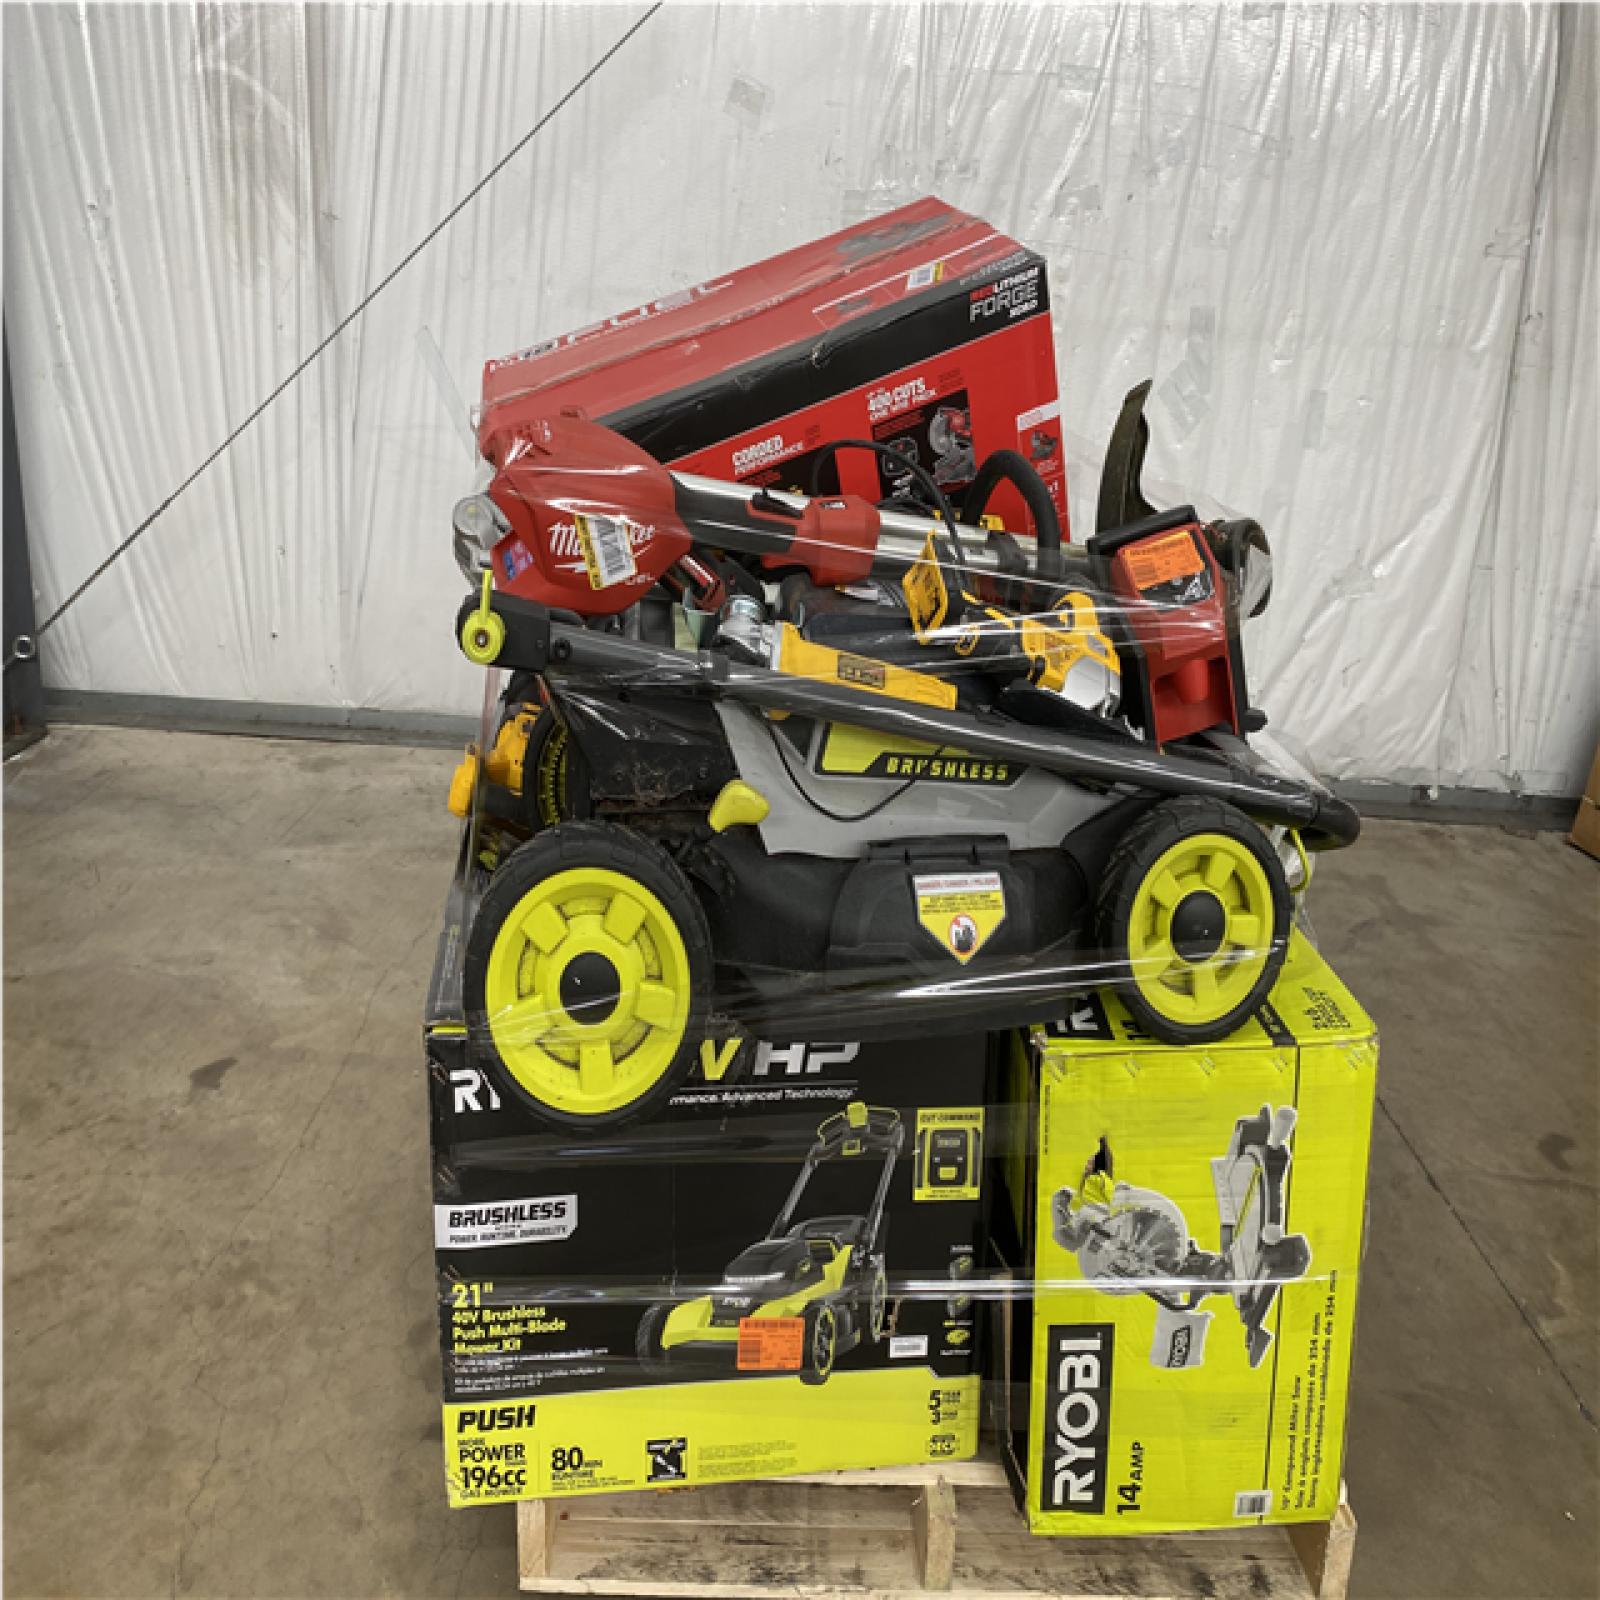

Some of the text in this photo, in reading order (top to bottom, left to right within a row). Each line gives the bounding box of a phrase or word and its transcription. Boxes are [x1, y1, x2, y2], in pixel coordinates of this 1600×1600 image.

[969, 279, 1039, 323] FORGE
[731, 434, 784, 466] CORDED
[752, 1040, 861, 1076] HP
[722, 1088, 783, 1103] Advanced
[449, 1201, 566, 1228] BRUSHLESS
[452, 1282, 494, 1309] 21"
[481, 1303, 547, 1323] Brushless
[452, 1317, 566, 1341] Push Multi-Blade
[457, 1404, 536, 1433] PUSH
[1052, 1339, 1101, 1506] RYOBI
[459, 1443, 525, 1464] POWER
[551, 1446, 583, 1471] 80
[460, 1464, 527, 1489] 196cc
[1116, 1441, 1145, 1515] 14 AMP
